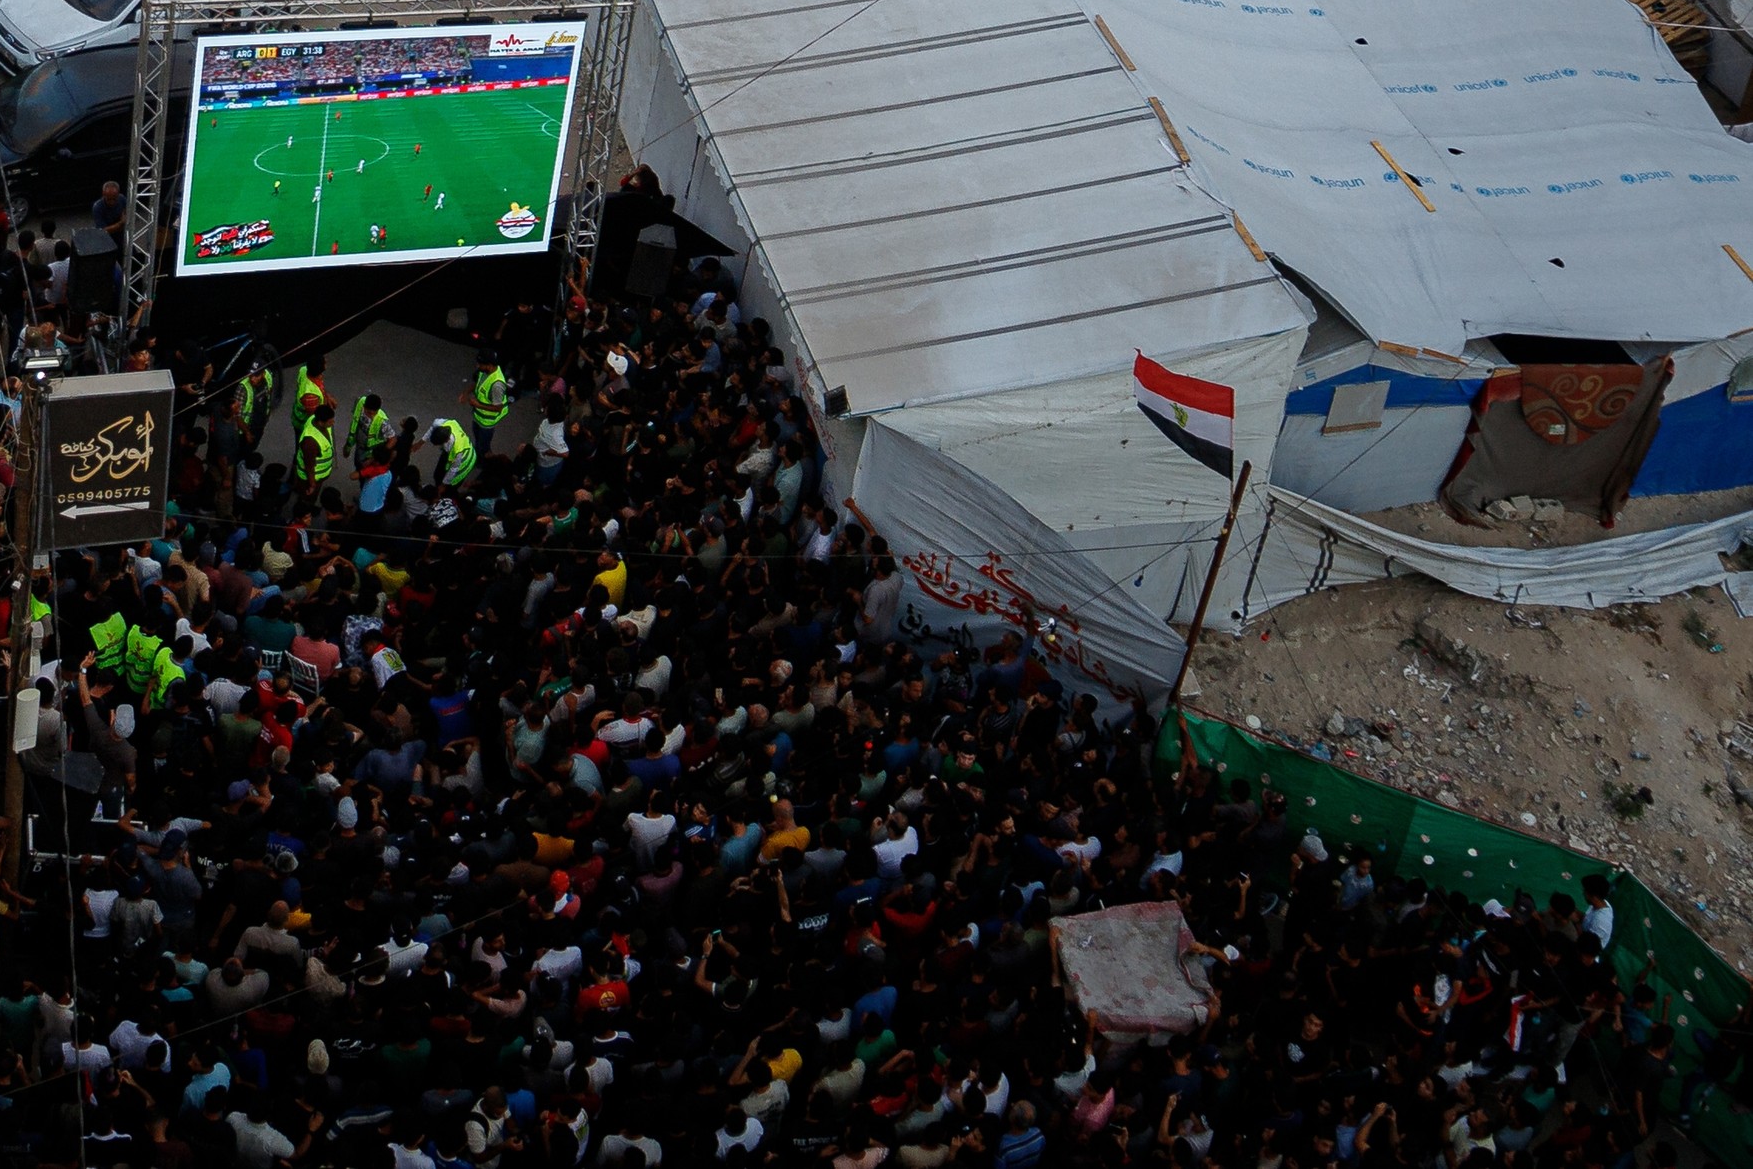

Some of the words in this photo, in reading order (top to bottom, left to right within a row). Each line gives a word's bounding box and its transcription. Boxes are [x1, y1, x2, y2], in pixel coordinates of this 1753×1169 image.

[1256, 5, 1293, 16] unicef
[236, 50, 252, 58] ARG
[281, 47, 297, 56] EGY
[1523, 70, 1562, 83] unicef
[1594, 68, 1628, 80] unicef
[1386, 84, 1422, 94] unicef
[1453, 79, 1491, 92] unicef
[1636, 169, 1674, 182] unicef
[1706, 173, 1740, 183] unicef
[1323, 177, 1365, 190] unicef
[1563, 178, 1604, 192] unicef
[1492, 186, 1531, 197] unicef
[58, 486, 151, 503] 0599405775
